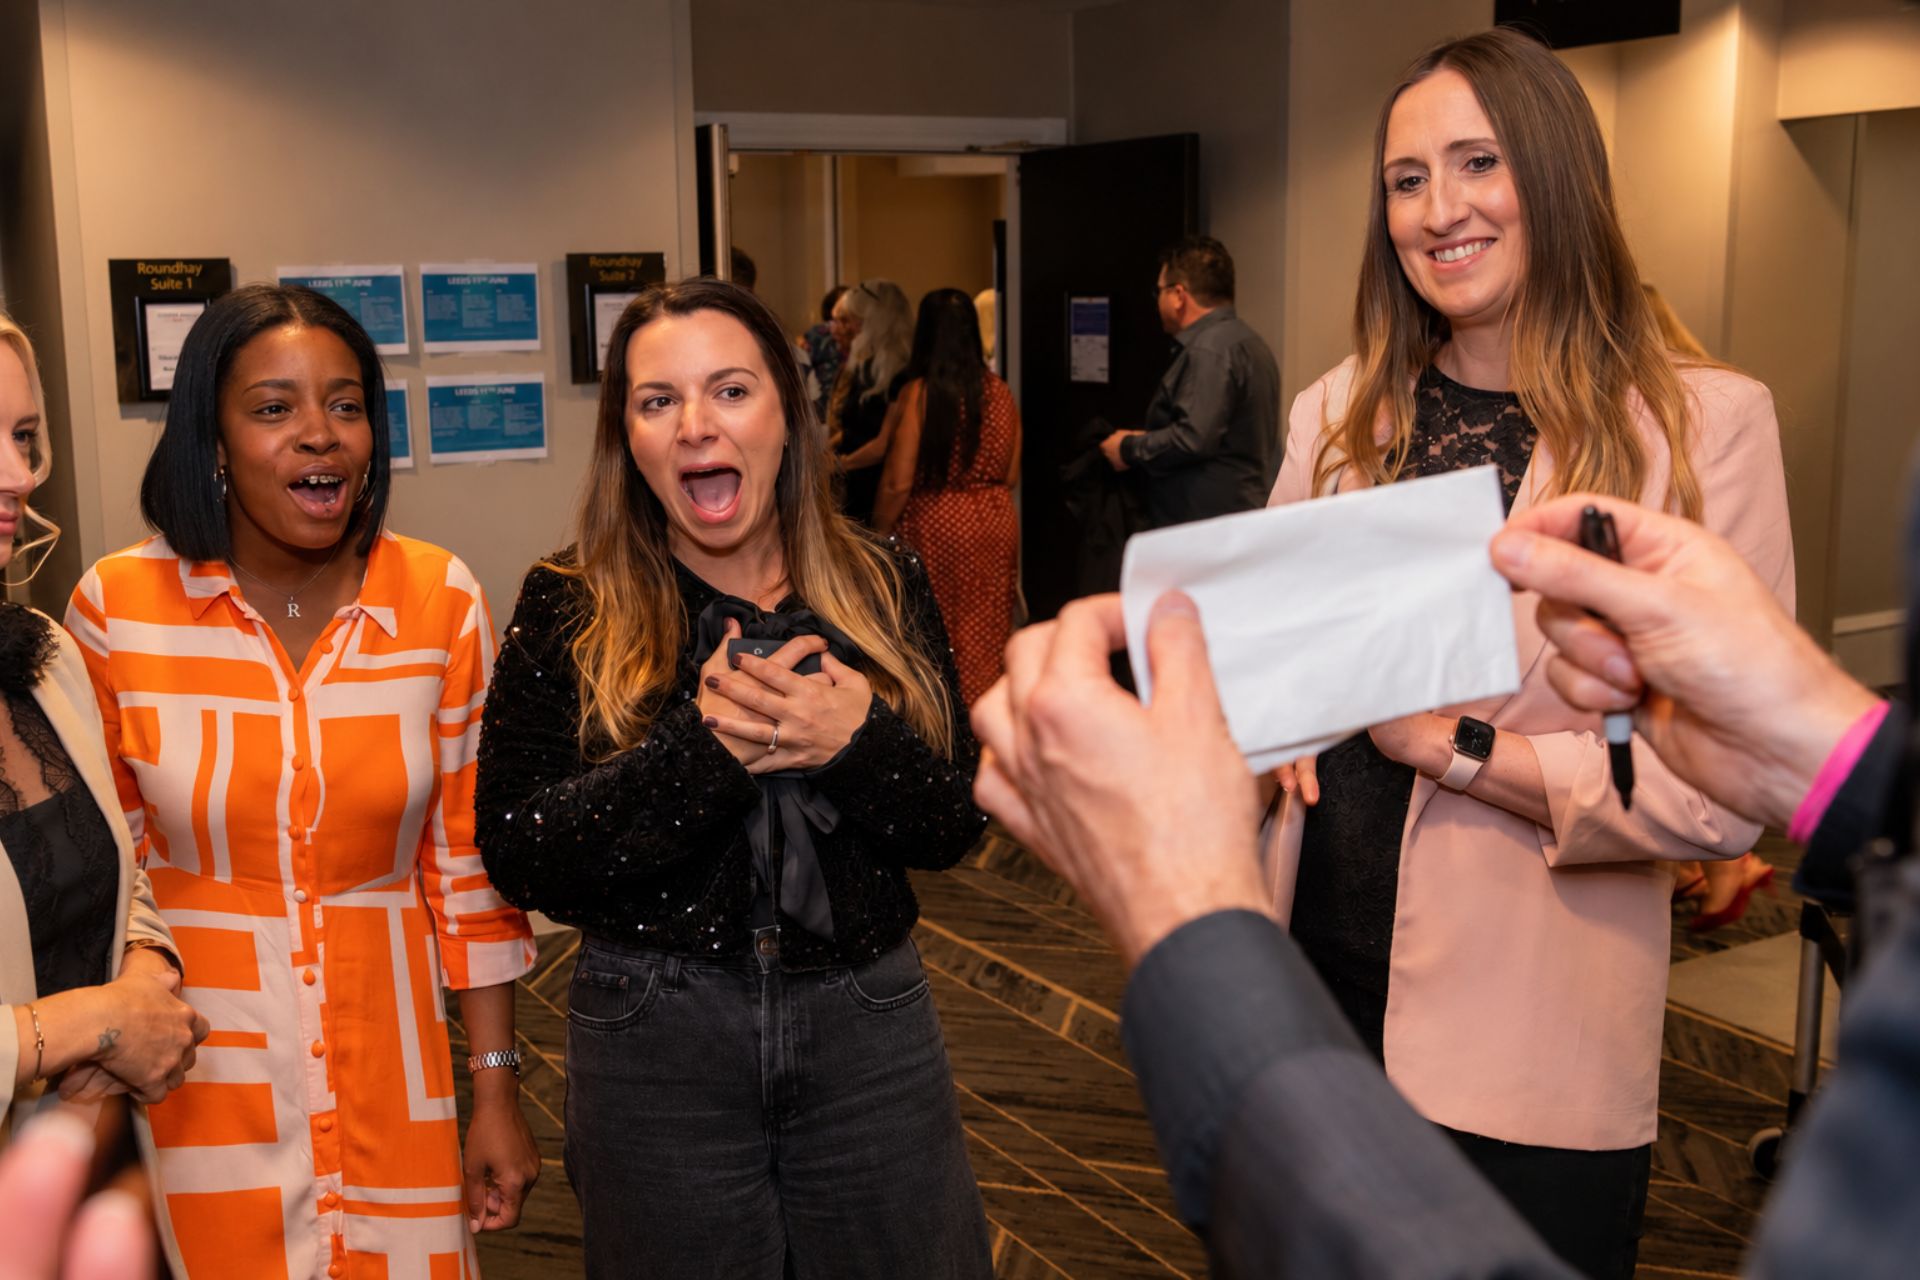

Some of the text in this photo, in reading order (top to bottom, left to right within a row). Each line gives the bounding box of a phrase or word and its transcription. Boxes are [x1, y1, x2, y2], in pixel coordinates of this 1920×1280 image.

[137, 261, 203, 277] Roundhay
[589, 255, 643, 270] Roundhay
[599, 269, 626, 282] Suite
[150, 277, 193, 290] Suite 1
[287, 603, 301, 617] R
